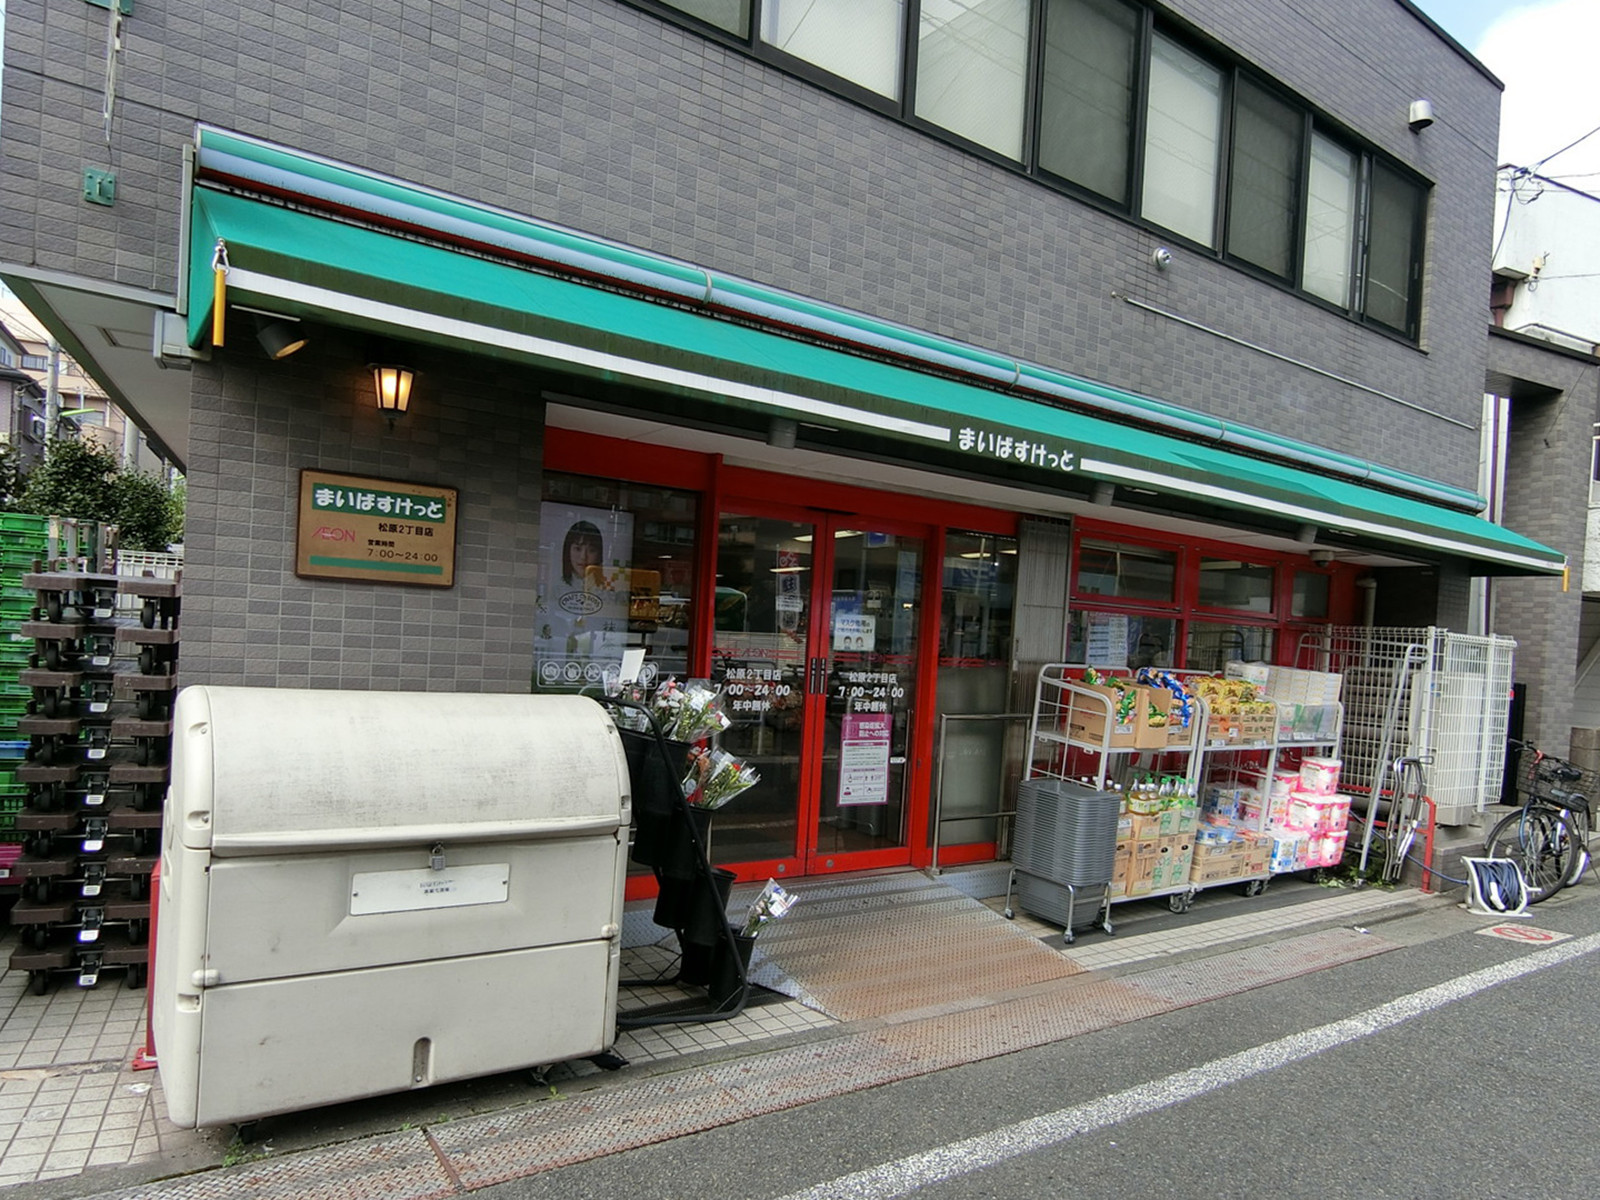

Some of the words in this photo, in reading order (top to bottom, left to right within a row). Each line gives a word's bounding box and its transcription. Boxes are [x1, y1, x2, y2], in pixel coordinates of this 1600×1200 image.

[958, 428, 1074, 471] まいばすけっと
[315, 488, 443, 519] まいばすけっと
[312, 527, 355, 542] AEON
[378, 522, 434, 537] 松原2丁目店
[726, 667, 782, 681] 松原2丁目店
[848, 671, 898, 684] 松原2丁目店
[713, 683, 791, 697] 700～24:00
[732, 699, 771, 711] 年中無休
